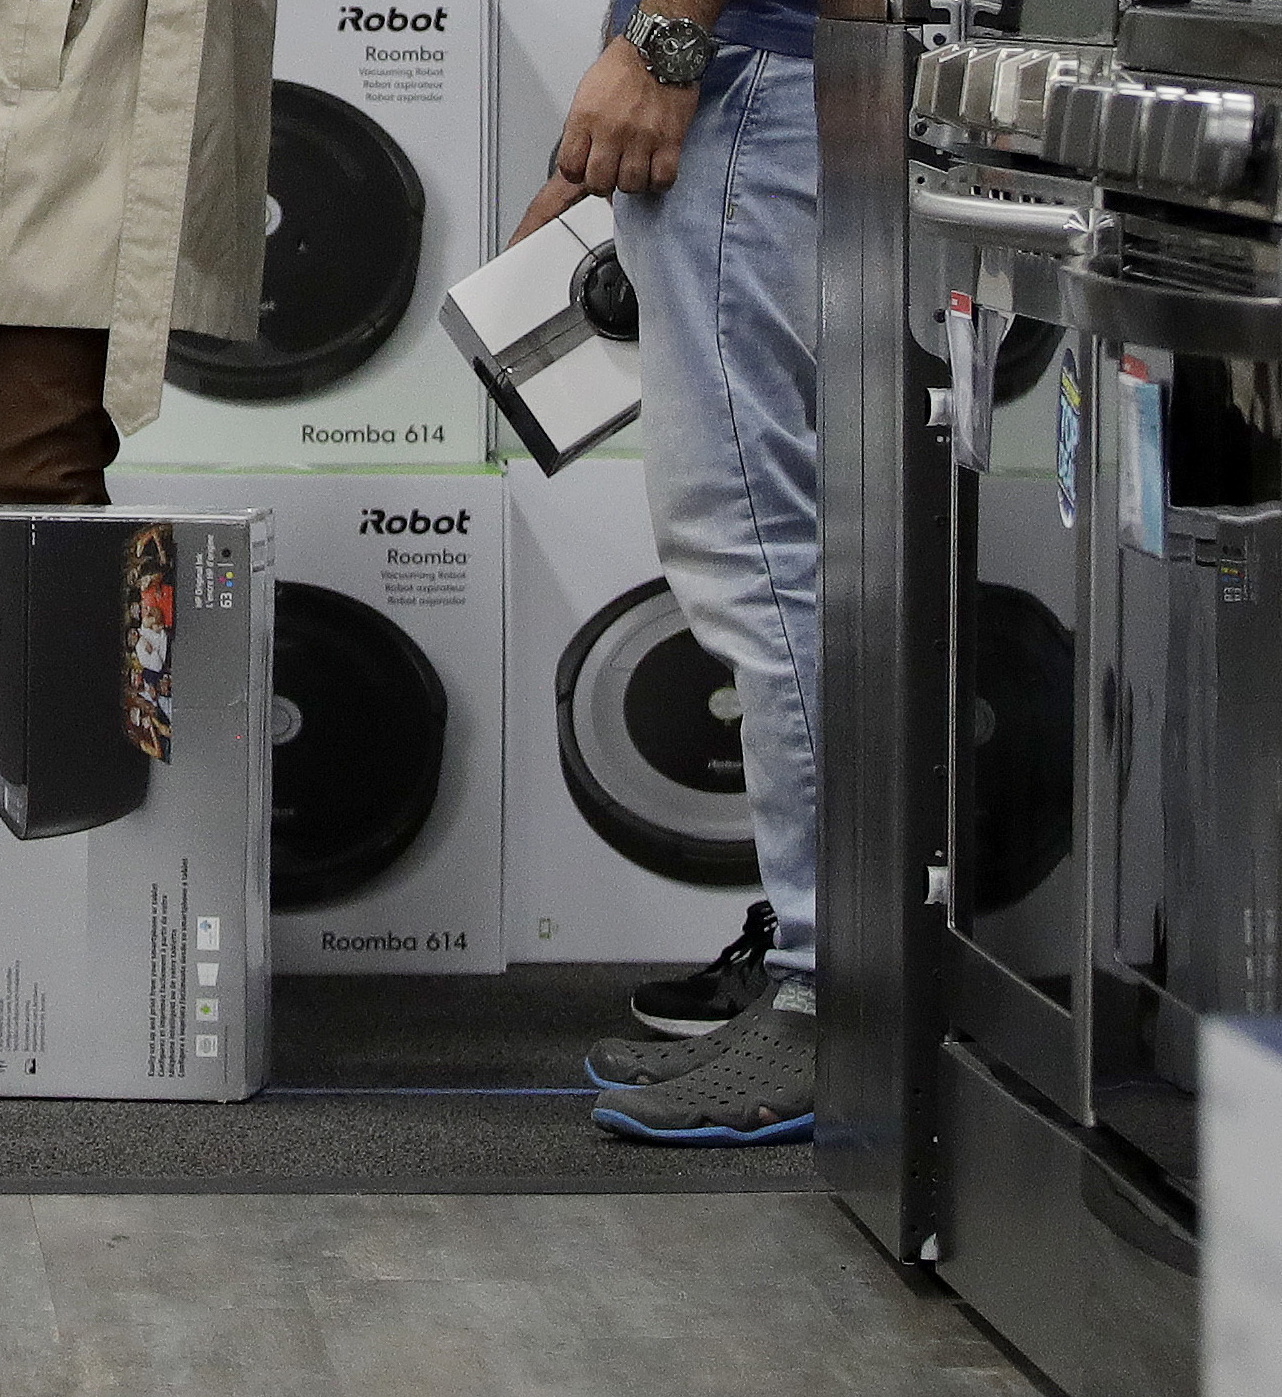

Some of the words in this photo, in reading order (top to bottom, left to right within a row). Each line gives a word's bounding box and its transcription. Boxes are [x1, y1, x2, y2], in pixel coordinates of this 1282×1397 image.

[338, 6, 448, 31] iRobot
[365, 46, 444, 61] Roomba
[359, 68, 413, 78] Vacuuming
[416, 68, 443, 76] Robot
[363, 80, 391, 88] Robot
[365, 93, 394, 101] Robot
[301, 425, 397, 444] Roomba
[404, 425, 445, 444] 614
[359, 508, 470, 535] iRobot
[387, 548, 466, 564] Roomba
[220, 592, 232, 608] 63
[387, 597, 416, 605] Robot
[321, 931, 417, 952] Roomba
[425, 931, 468, 952] 614
